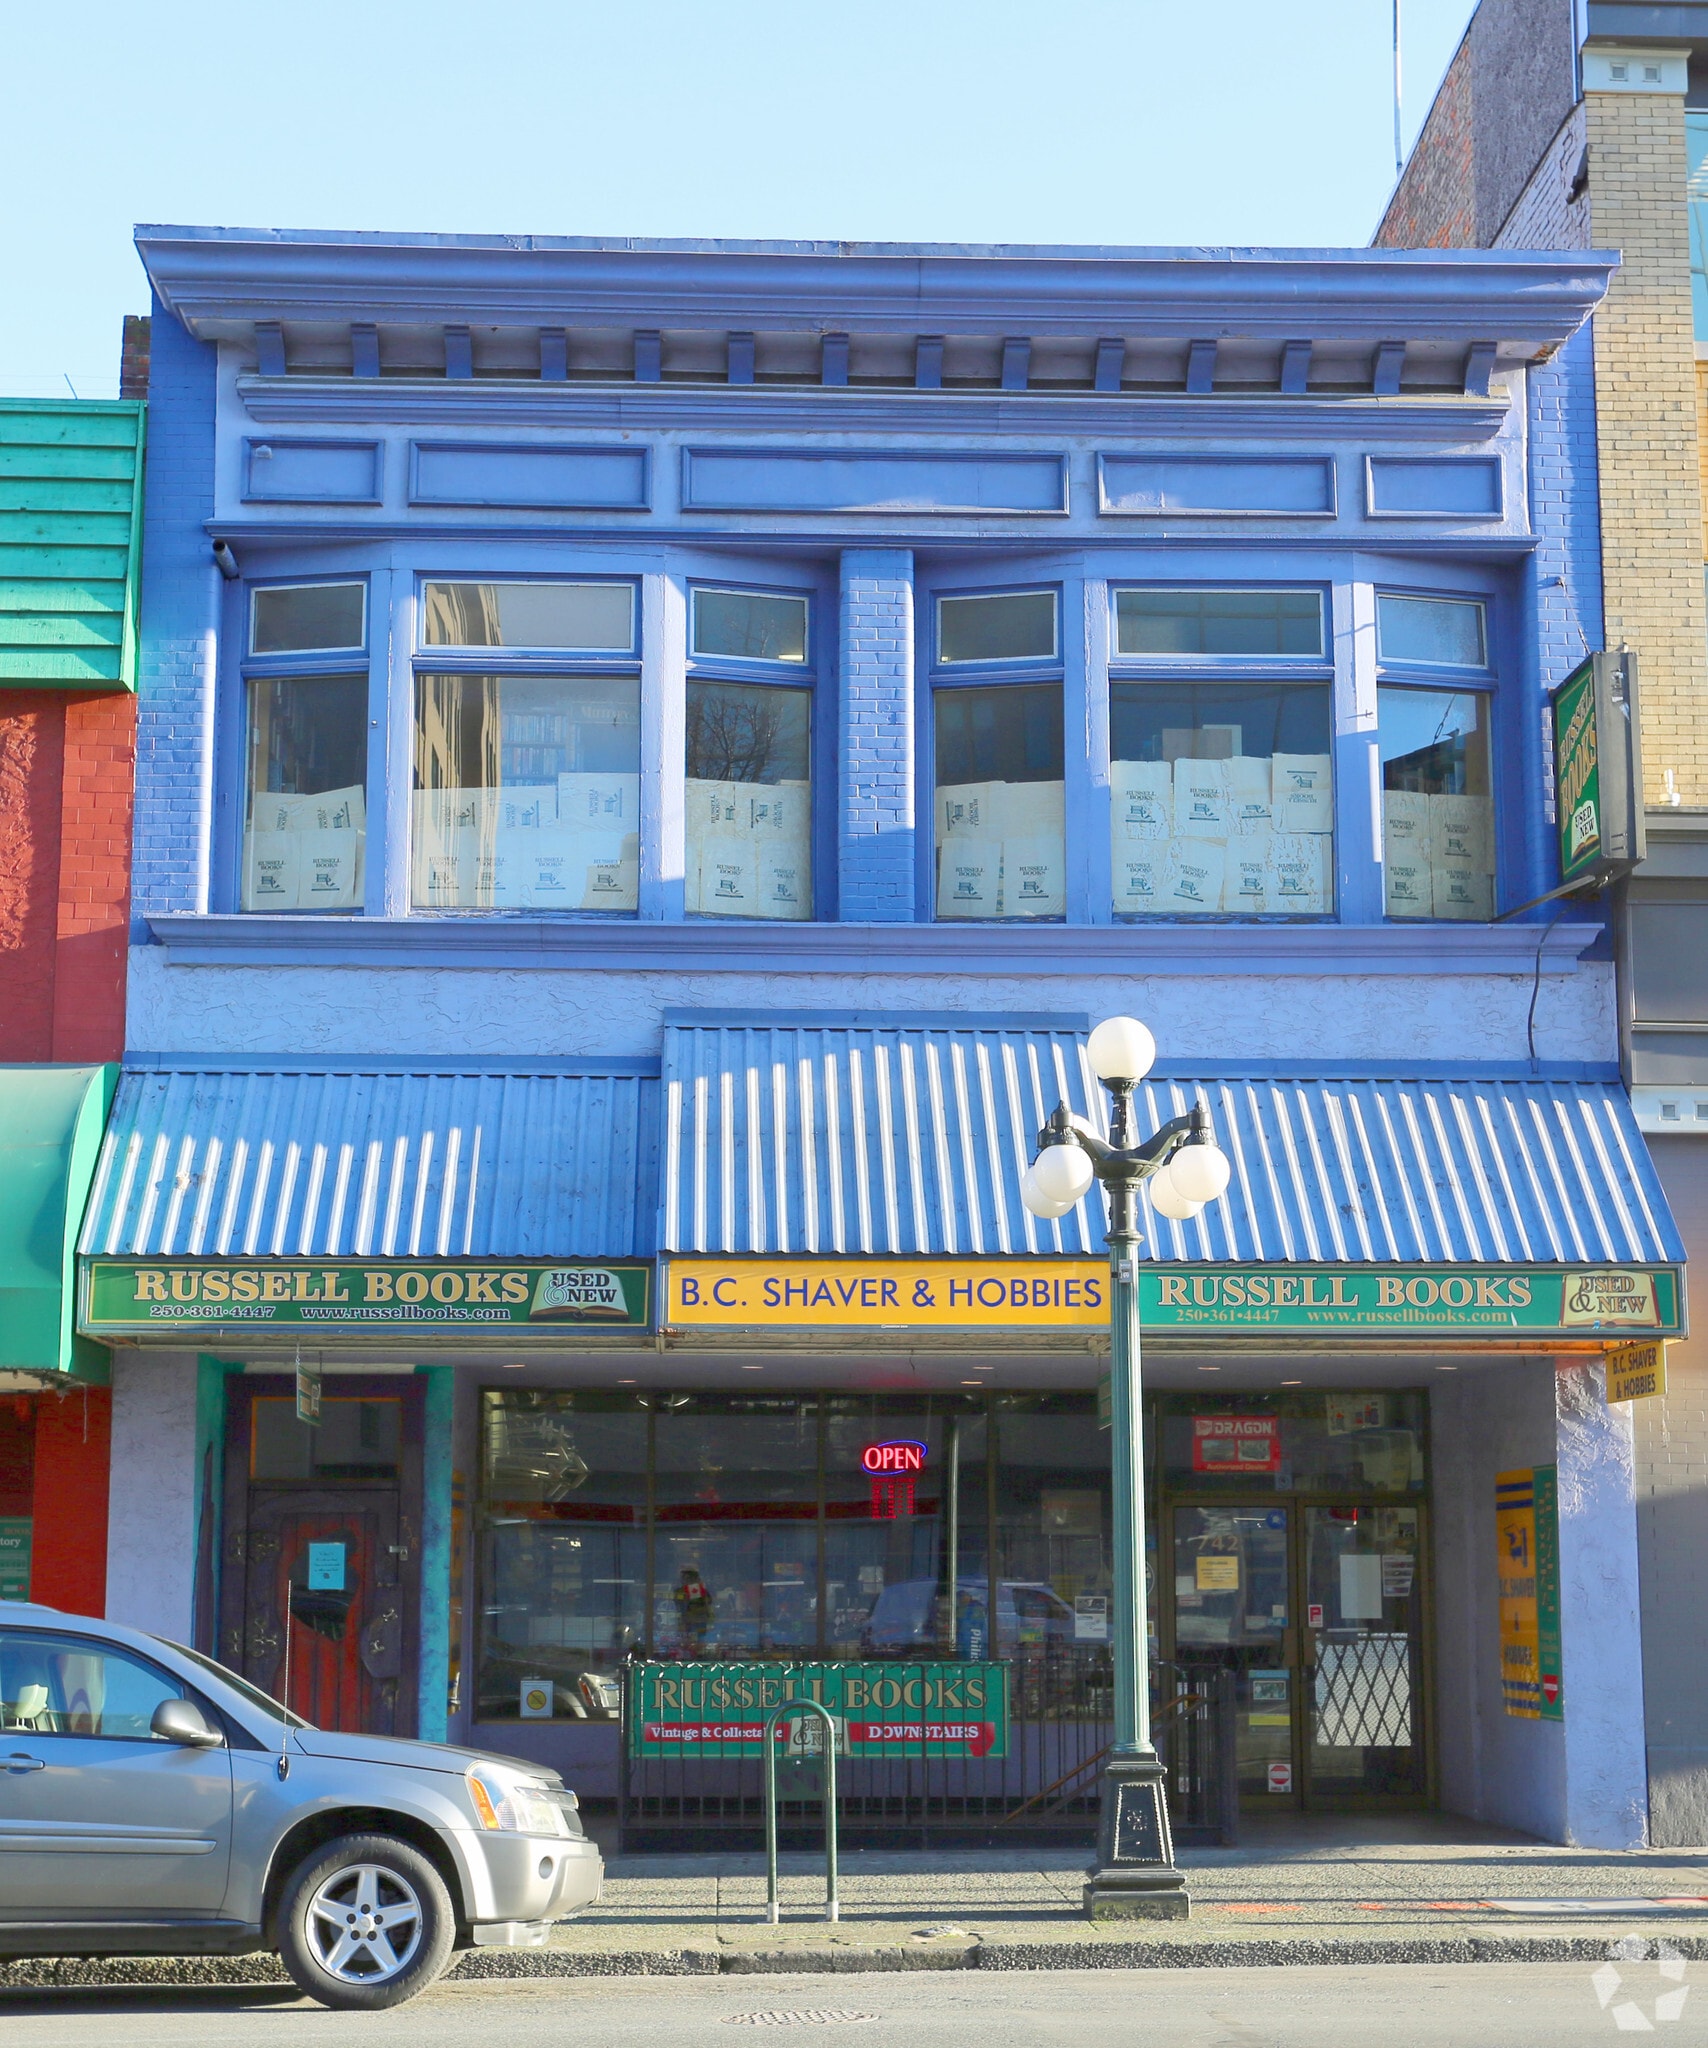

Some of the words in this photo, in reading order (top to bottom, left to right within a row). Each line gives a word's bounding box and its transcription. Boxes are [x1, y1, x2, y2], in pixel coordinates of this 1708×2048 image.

[1560, 672, 1595, 778] RUSSELL
[1561, 712, 1598, 835] BOOKS
[1574, 804, 1593, 829] USED
[1579, 820, 1596, 839] NEW
[133, 1270, 350, 1302] RUSSELL
[362, 1271, 530, 1304] BOOKS
[551, 1273, 610, 1287] USED
[1157, 1275, 1360, 1307] RUSSELL
[1374, 1276, 1533, 1308] BOOKS
[1579, 1276, 1635, 1293] USED
[567, 1289, 617, 1302] NEW
[681, 1277, 747, 1307] B.C.
[762, 1277, 901, 1307] SHAVER
[911, 1277, 936, 1308] &
[949, 1278, 1103, 1308] HOBBIES
[1569, 1284, 1596, 1313] &
[1597, 1296, 1648, 1313] NEW
[299, 1305, 511, 1320] www.russellbooks.com
[1306, 1309, 1508, 1323] www.russellbooks.com
[1612, 1354, 1626, 1375] B.C.
[1628, 1347, 1657, 1372] SHAVER
[1616, 1380, 1622, 1399] &
[1623, 1373, 1656, 1398] HOBBIES
[1214, 1422, 1272, 1434] DRAGON
[864, 1447, 920, 1470] OPEN
[652, 1678, 836, 1709] RUSSELL
[844, 1678, 988, 1709] BOOKS
[651, 1727, 699, 1741] Vintage
[702, 1727, 711, 1739] &
[868, 1726, 979, 1739] DOWNSTAIRS
